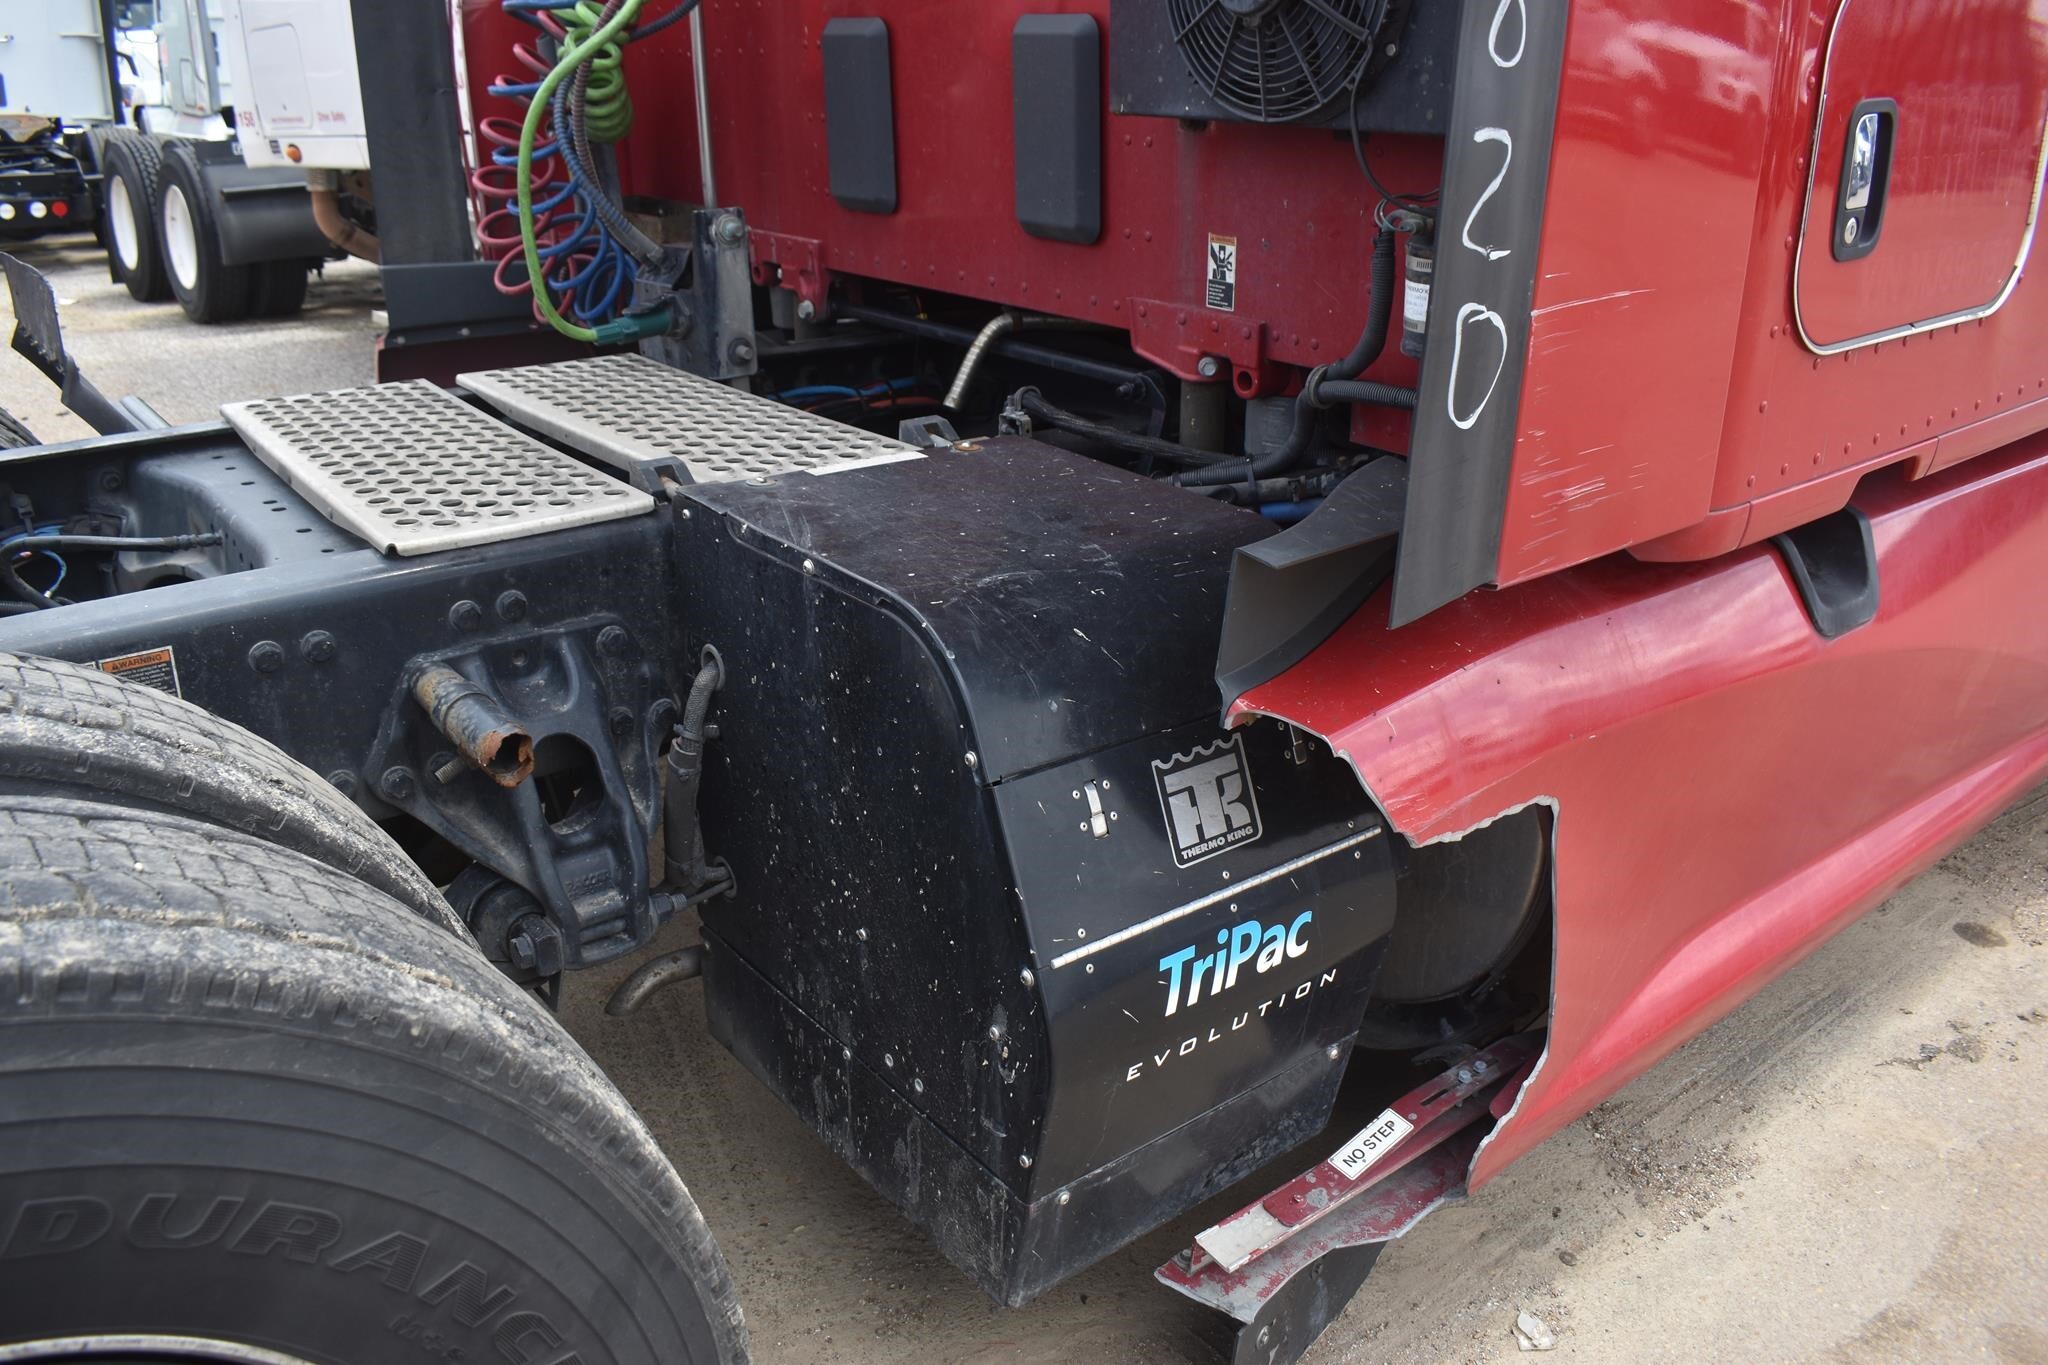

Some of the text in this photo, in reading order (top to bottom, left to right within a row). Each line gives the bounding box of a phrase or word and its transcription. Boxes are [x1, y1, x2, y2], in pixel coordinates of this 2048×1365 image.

[119, 653, 162, 669] WARNING
[1180, 825, 1254, 860] THERMO KING
[1159, 911, 1313, 1017] TriPac
[1126, 968, 1337, 1082] EVOLUTION
[1342, 1120, 1396, 1168] NO STEP
